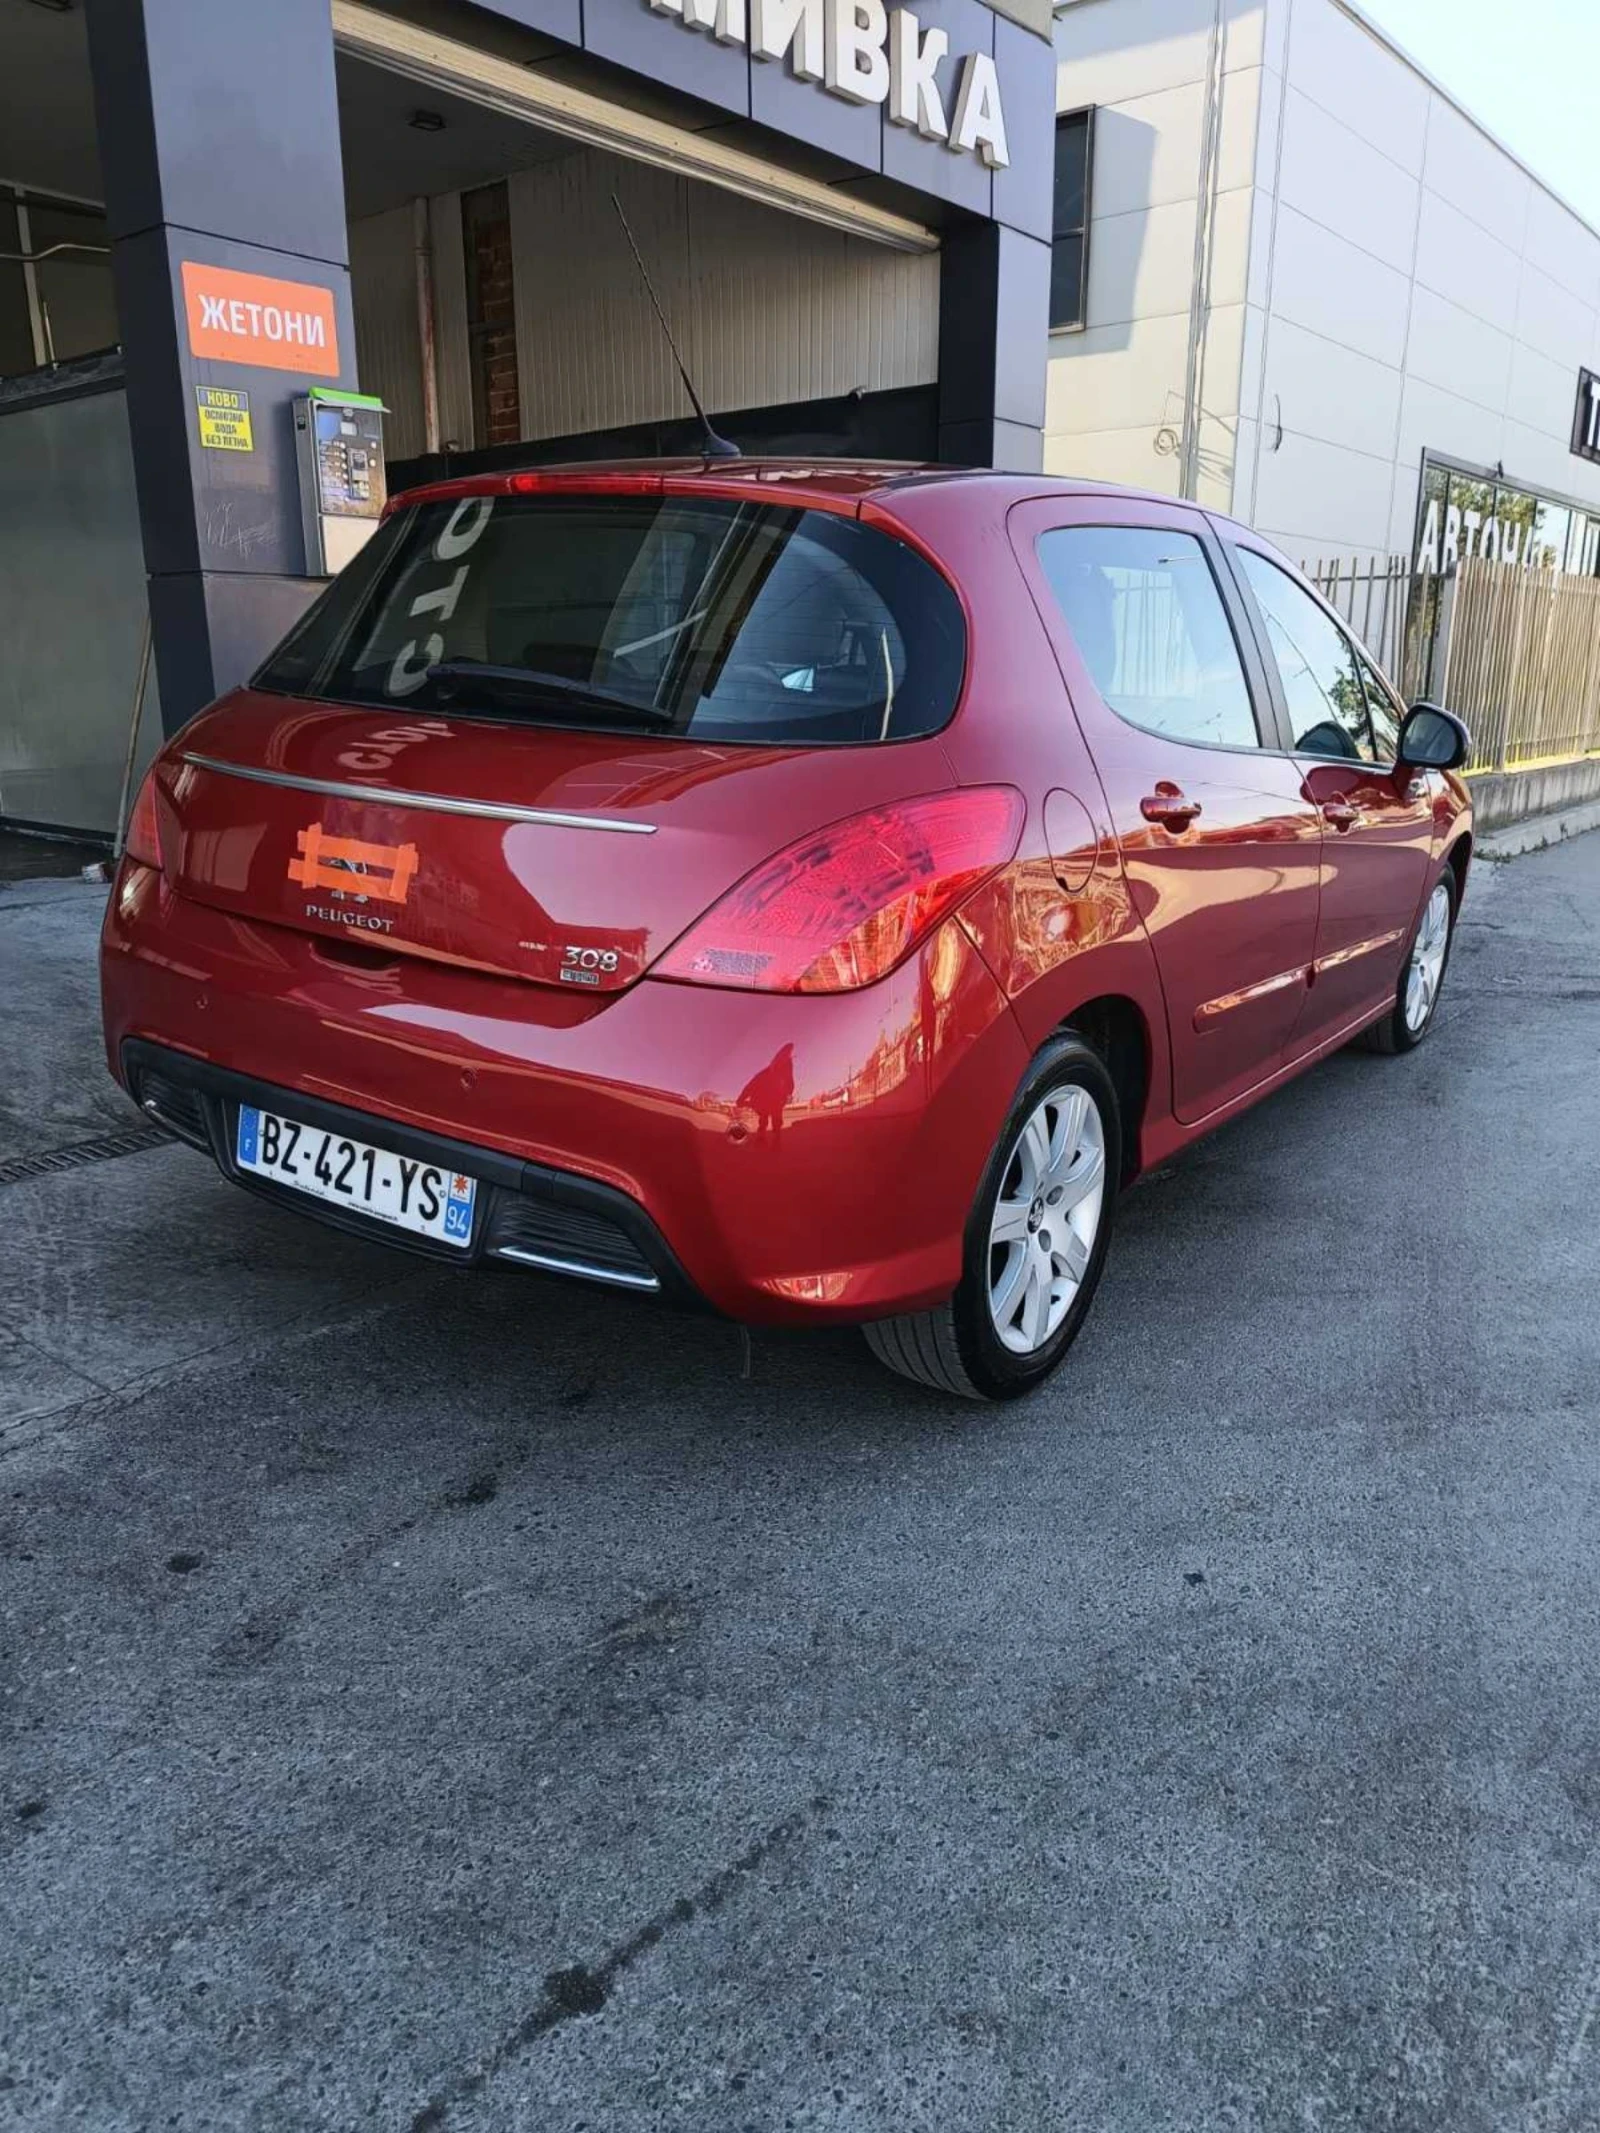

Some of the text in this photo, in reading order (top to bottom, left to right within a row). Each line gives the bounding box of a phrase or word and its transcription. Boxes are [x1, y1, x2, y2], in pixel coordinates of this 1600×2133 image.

[198, 294, 325, 348] ЖЕТОНИ
[207, 390, 239, 408] НОВО
[306, 904, 394, 933] PEUGEOT
[560, 945, 618, 972] 308
[262, 1114, 442, 1221] BZ-421-YS
[446, 1206, 467, 1234] 94
